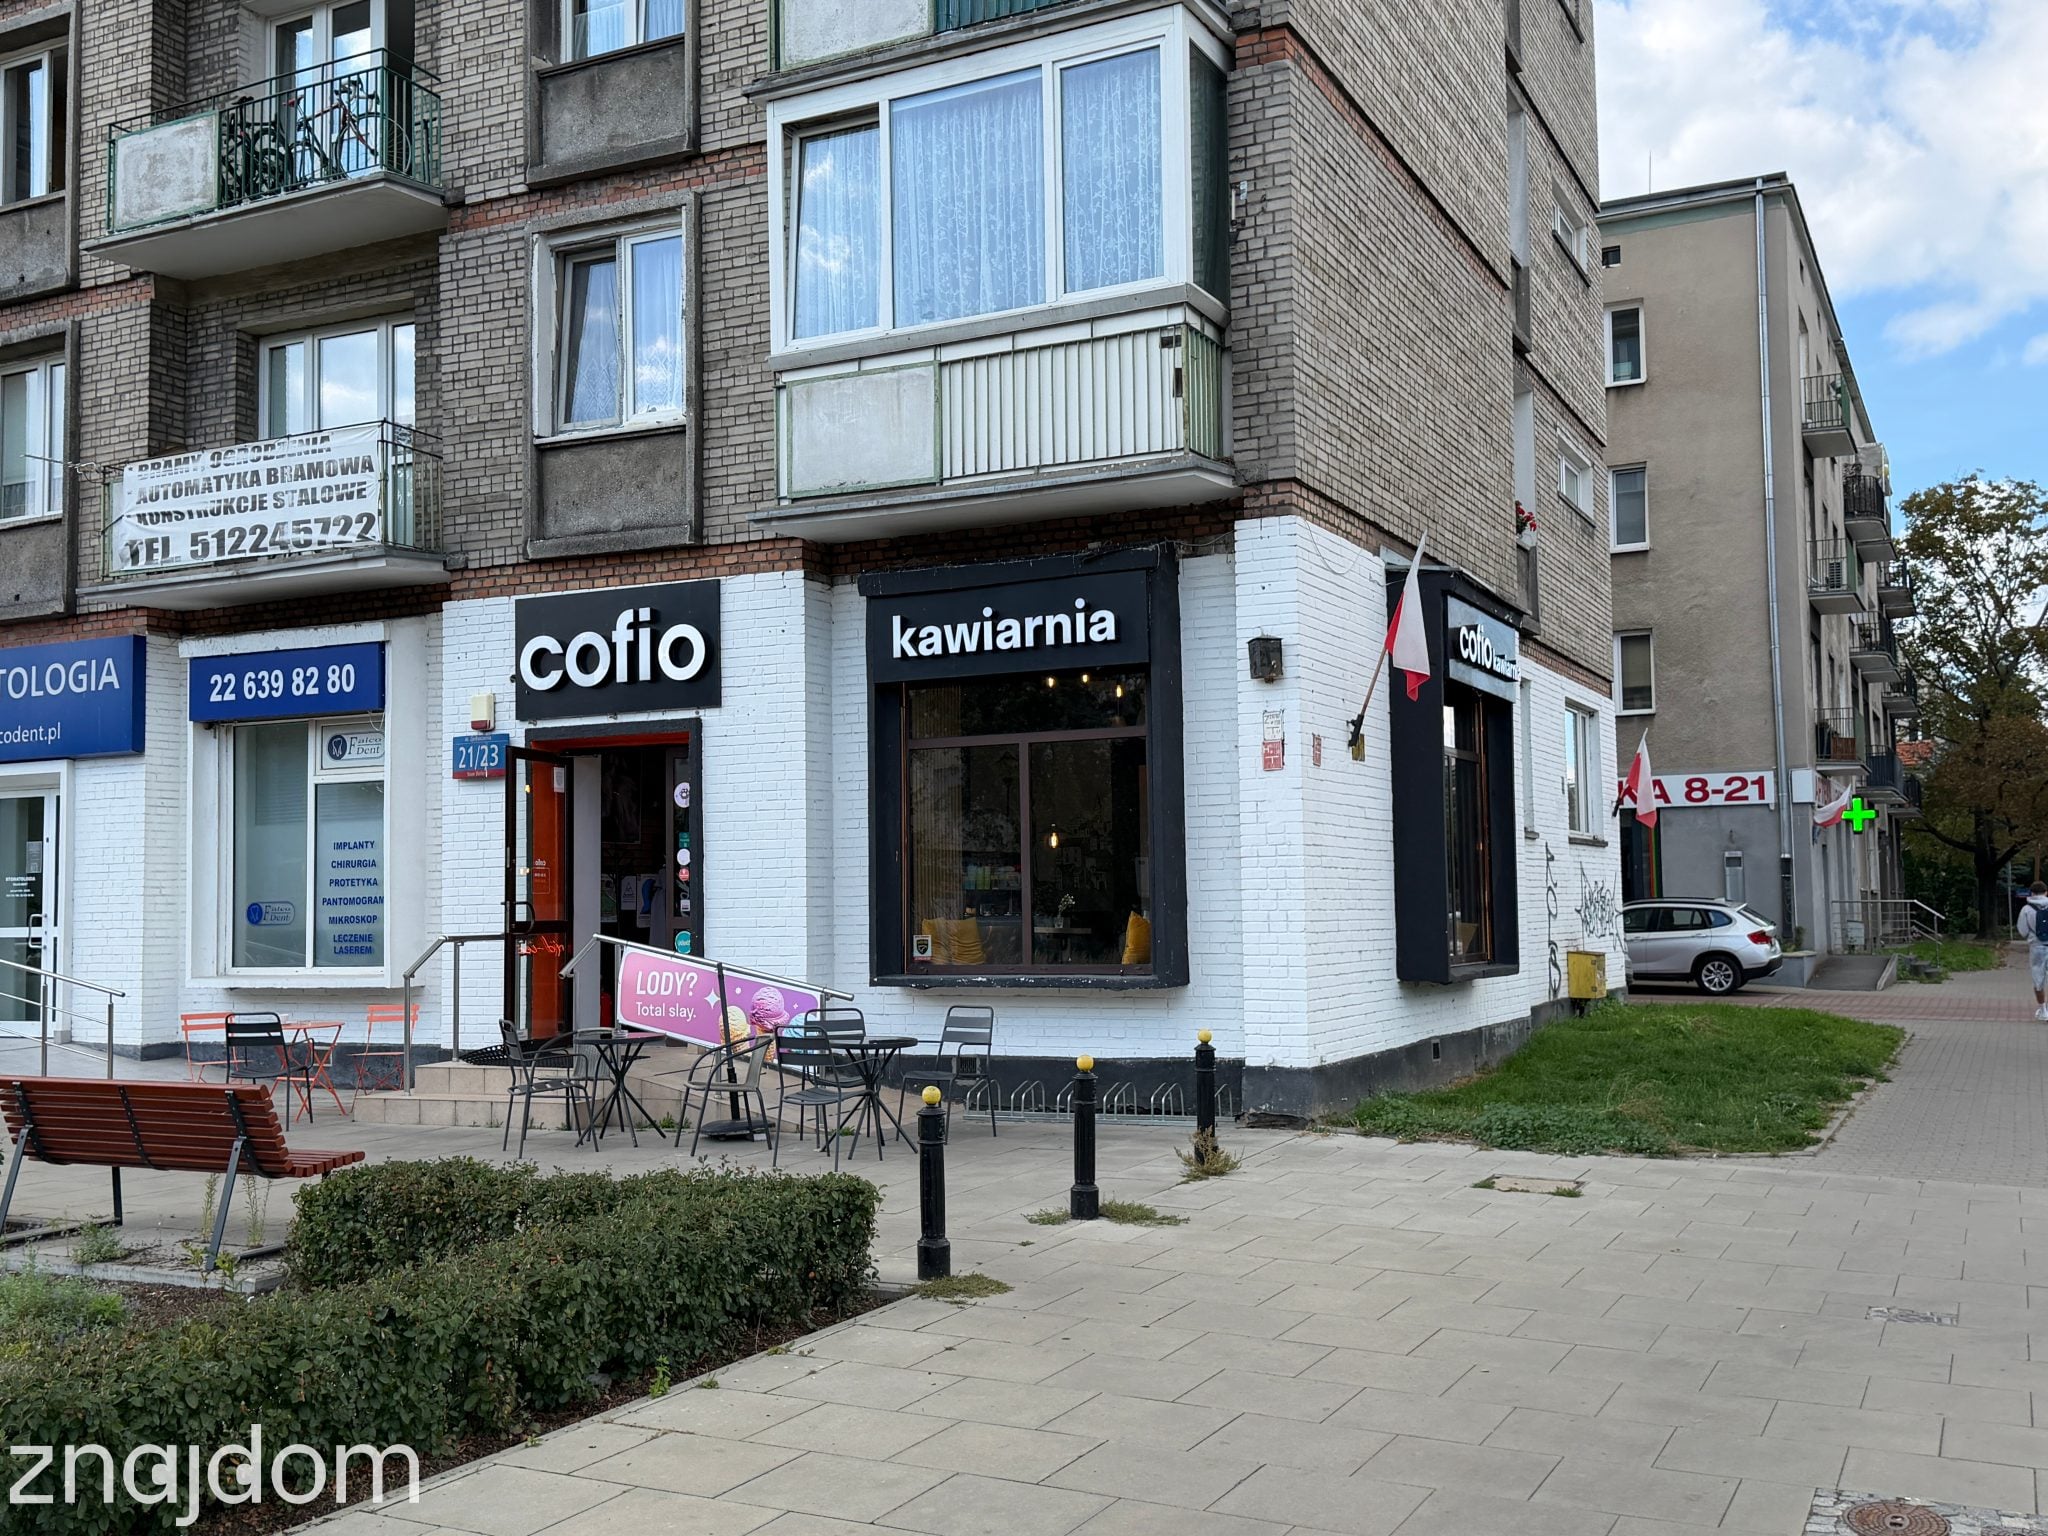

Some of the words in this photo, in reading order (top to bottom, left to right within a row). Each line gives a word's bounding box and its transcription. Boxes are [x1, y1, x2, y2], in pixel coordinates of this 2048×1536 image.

[210, 435, 332, 469] OGRODZENIA
[136, 470, 262, 504] AUTOMATYKA
[266, 455, 374, 485] BRAMOWA
[136, 498, 268, 526] KONSTRUKCJE
[273, 481, 367, 509] STALOWE
[190, 512, 376, 561] 512245722
[892, 598, 1116, 659] kawiarnia
[520, 607, 706, 691] cofio
[1460, 624, 1492, 669] cofio
[210, 673, 236, 702] 22
[243, 669, 284, 700] 639
[291, 666, 319, 697] 82
[327, 663, 355, 694] 80
[357, 746, 380, 755] Dent
[458, 744, 499, 771] 21/23
[1684, 776, 1766, 803] 8-21
[333, 840, 375, 850] IMPLANTY
[331, 859, 377, 869] CHIRURGIA
[329, 878, 378, 887] PROTETYKA
[328, 915, 378, 924] MIKROSKOP
[333, 934, 374, 943] LECZENIE
[333, 946, 373, 955] LASEREM
[636, 971, 698, 997] LODY?
[636, 1002, 665, 1017] Total
[669, 1003, 697, 1022] slay.
